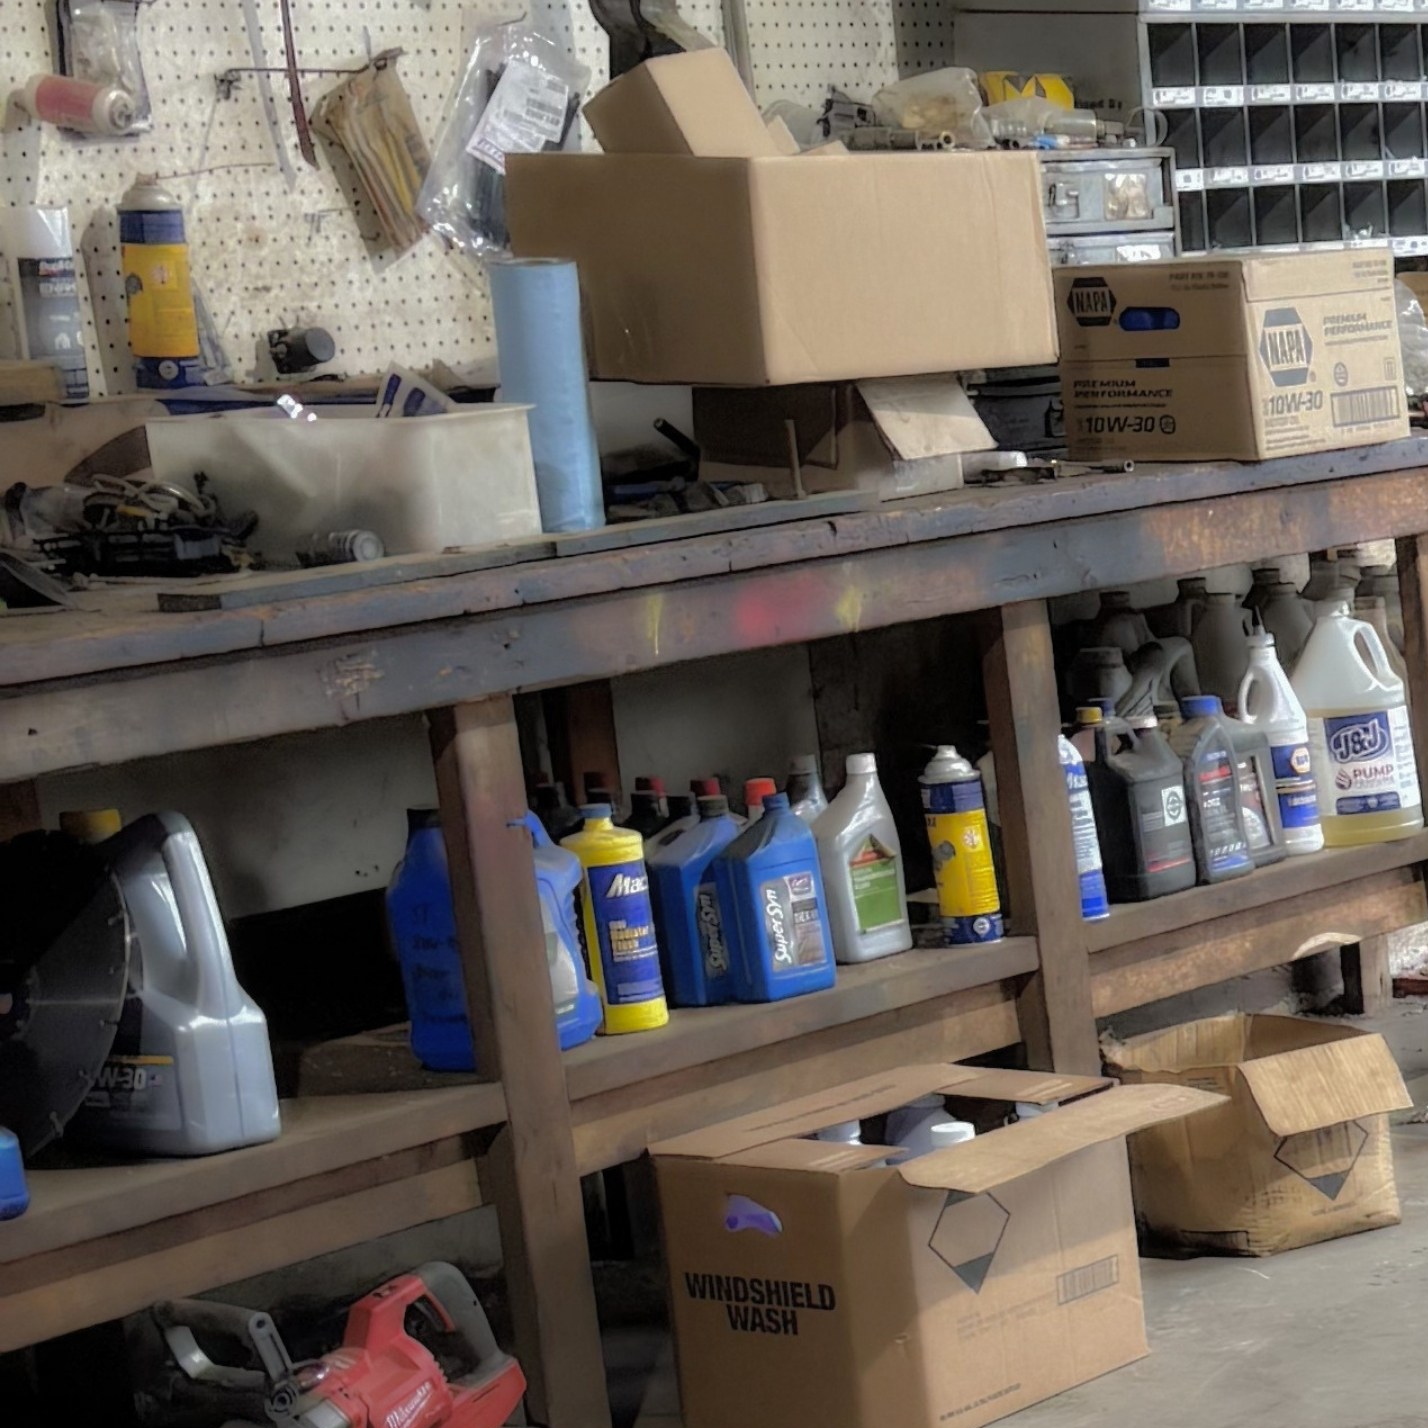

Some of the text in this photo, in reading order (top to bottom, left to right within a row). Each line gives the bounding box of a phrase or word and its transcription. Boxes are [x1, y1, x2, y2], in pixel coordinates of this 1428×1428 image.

[1074, 290, 1109, 314] NAPA
[1324, 320, 1393, 337] PERFORMANCE
[1267, 329, 1305, 366] NAPA
[1072, 379, 1137, 389] PREMIUM
[1072, 389, 1173, 399] PERFORMANCE
[1269, 390, 1323, 416] 10W-30
[1085, 416, 1156, 434] 10W-30
[1333, 718, 1380, 762] J&J
[1352, 764, 1394, 779] PUMP
[766, 889, 793, 964] SuperSyn
[98, 1066, 147, 1090] W-30
[685, 1272, 837, 1311] WINDSHIELD
[726, 1303, 799, 1336] WASH
